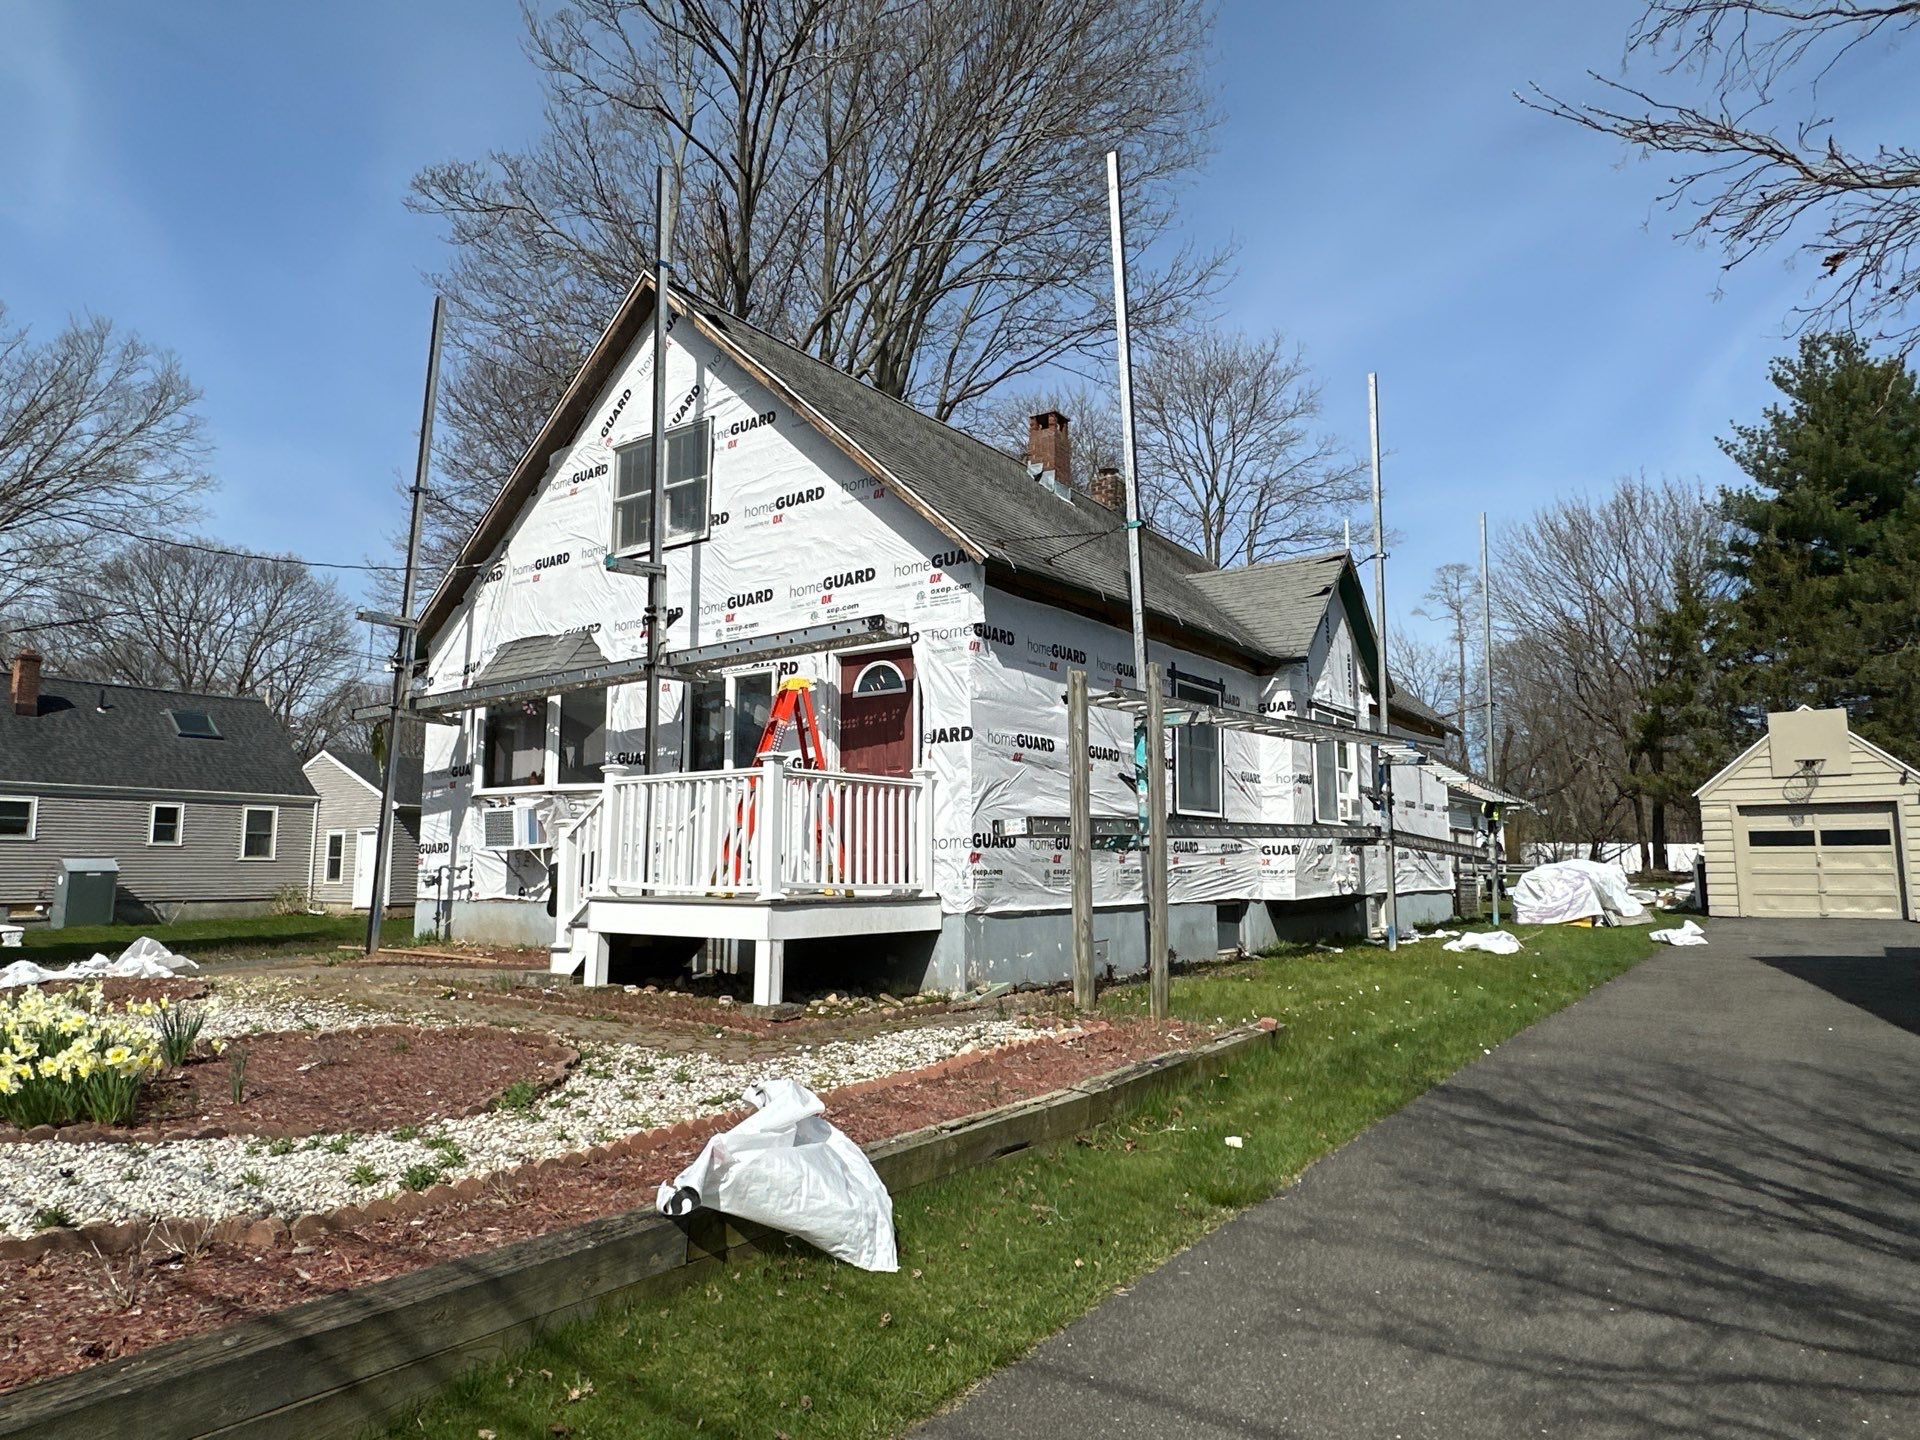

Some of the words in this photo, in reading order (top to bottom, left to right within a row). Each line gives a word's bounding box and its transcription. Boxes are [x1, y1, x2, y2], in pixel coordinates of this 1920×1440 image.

[667, 384, 701, 426] UARD
[727, 439, 739, 449] OX
[550, 463, 609, 491] homeGUARD
[873, 488, 885, 499] OX
[744, 486, 825, 519] homeGUARD
[772, 513, 784, 525] OX
[512, 552, 570, 576] homeGUARD
[789, 567, 876, 599] homeGUARD
[929, 572, 943, 584] OX
[699, 588, 774, 616] homeGUARD
[821, 594, 834, 605] OX
[725, 612, 737, 624] OX
[931, 622, 1015, 647] homeGUARD
[968, 640, 981, 653] OX
[1027, 635, 1087, 666] homeGUARD
[987, 730, 1055, 753] homeGUARD
[1012, 752, 1024, 763] OX
[969, 852, 982, 864] OX
[1053, 854, 1062, 864] OX
